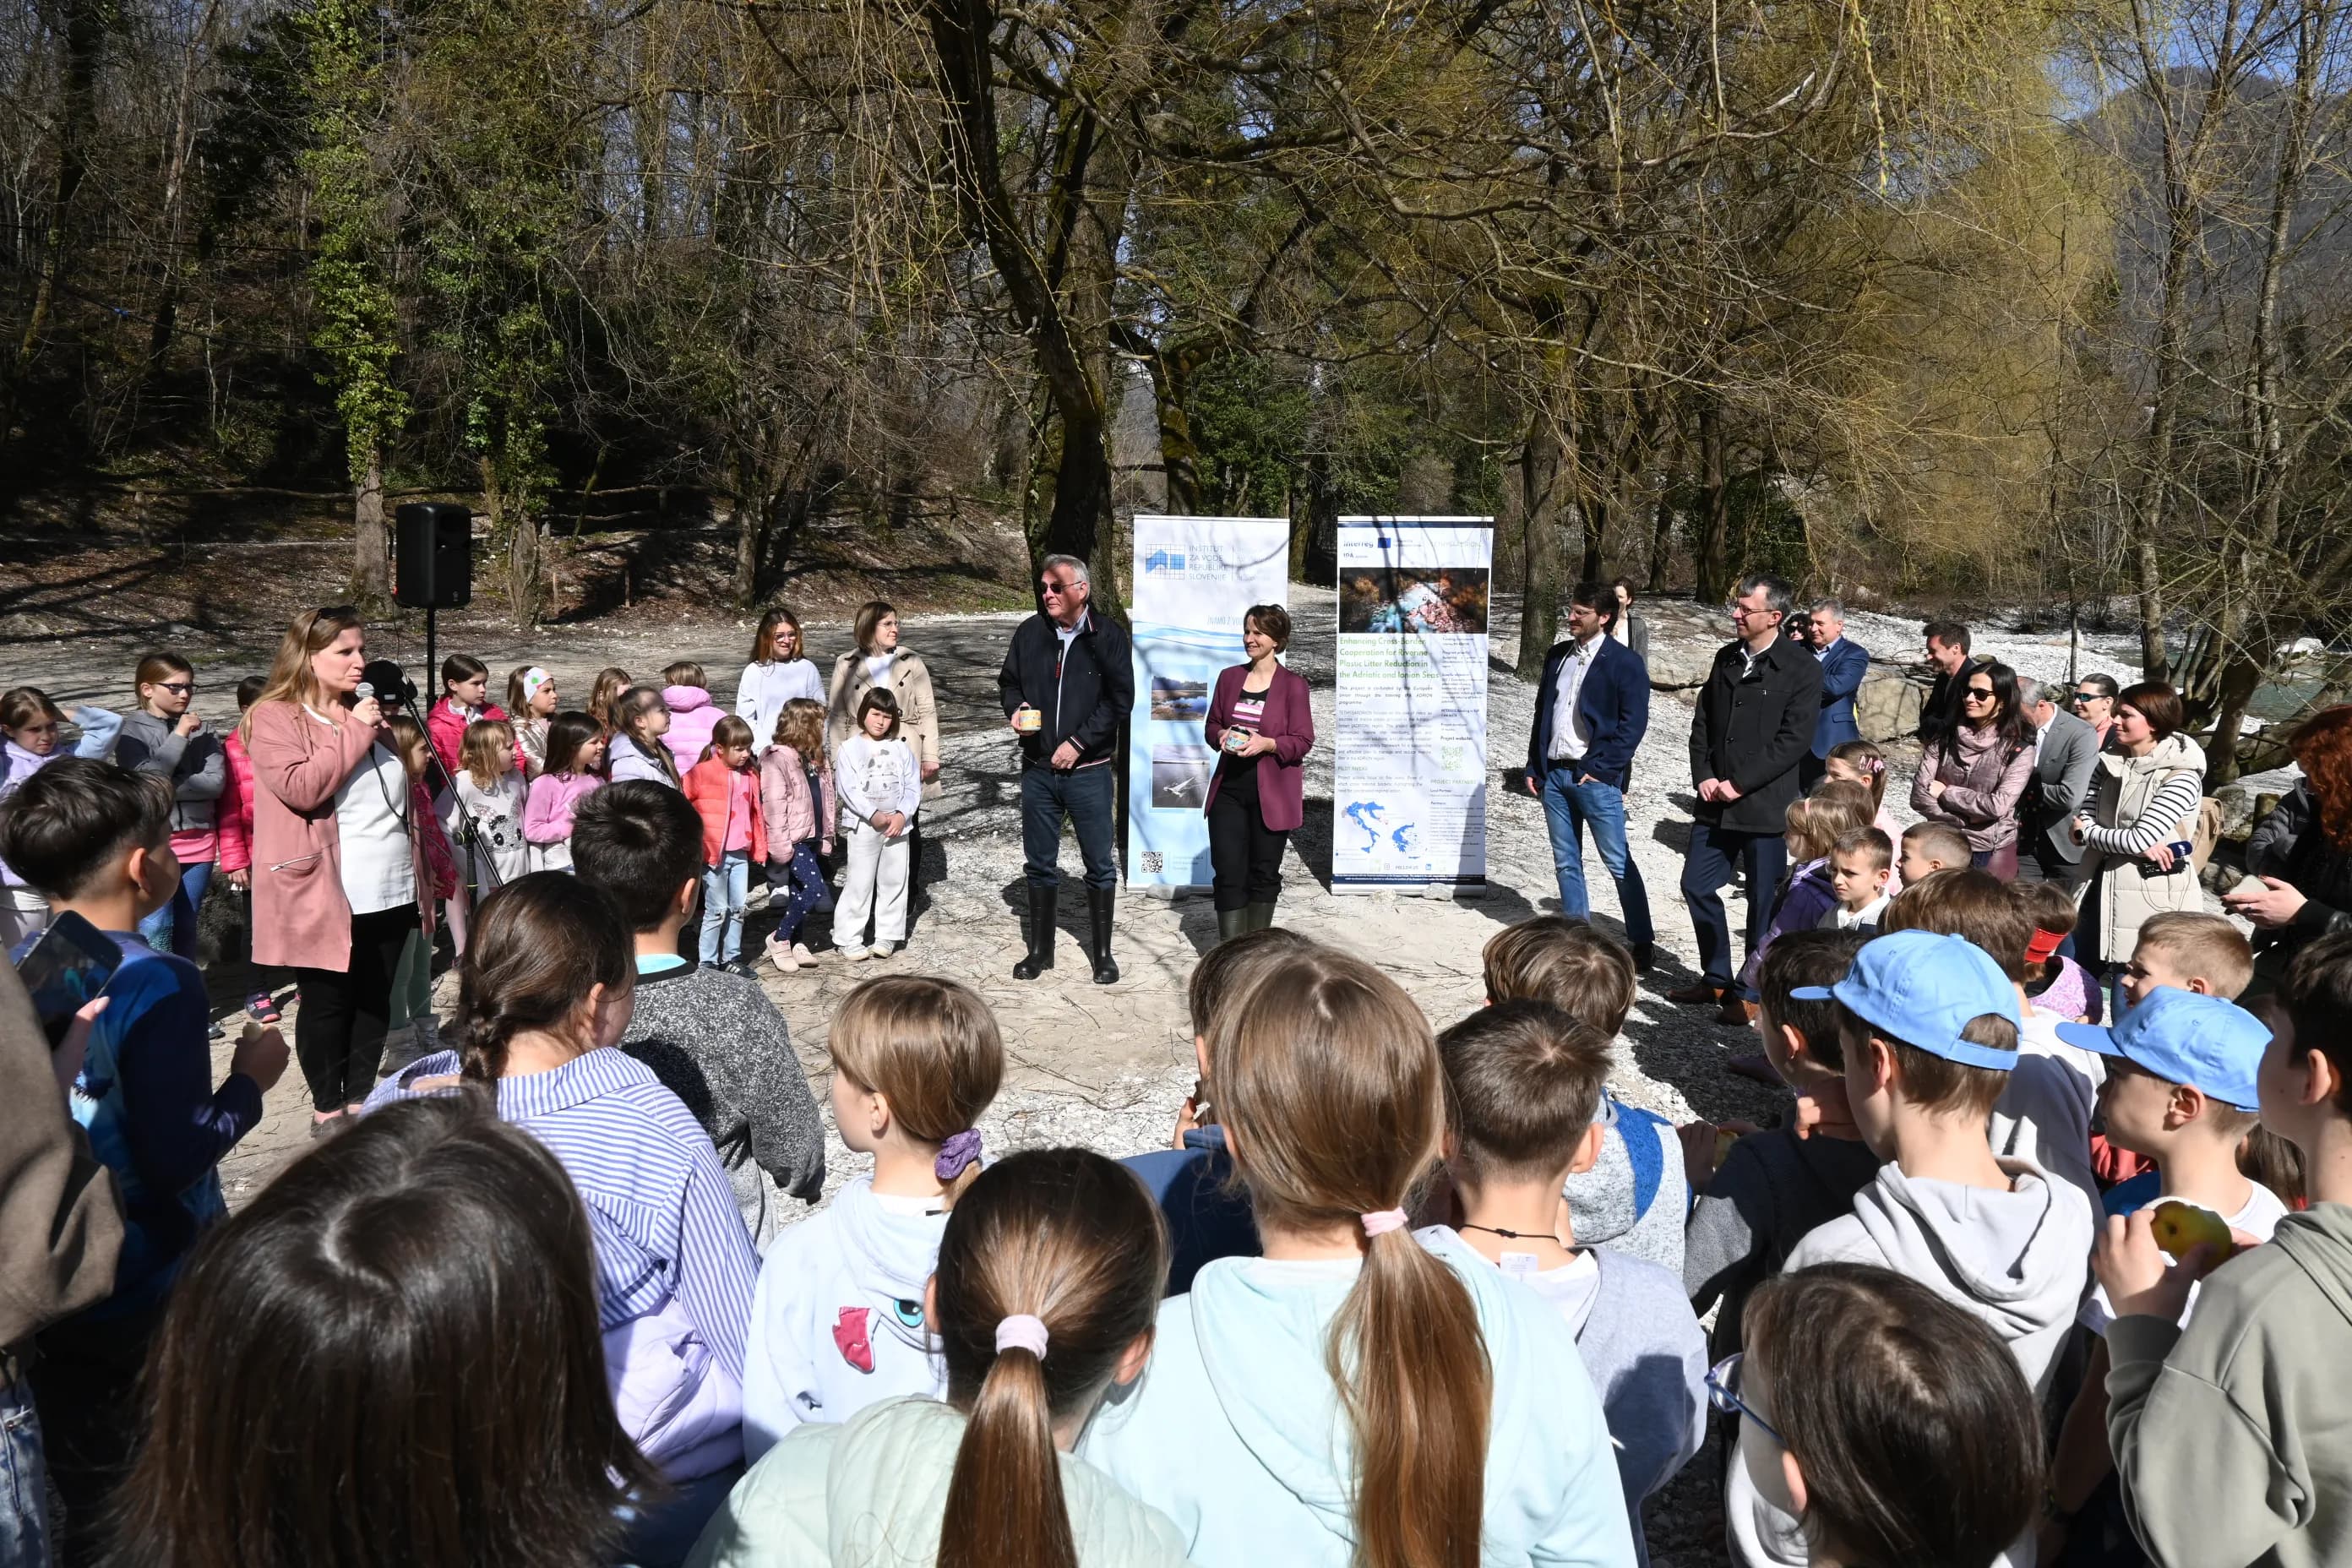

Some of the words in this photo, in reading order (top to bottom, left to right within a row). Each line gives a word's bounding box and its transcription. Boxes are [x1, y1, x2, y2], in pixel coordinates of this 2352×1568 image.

[1339, 637, 1377, 647] Enhancing
[1339, 648, 1385, 656] Cooperation
[1398, 648, 1428, 656] Riverine
[1364, 659, 1383, 667] Litter
[1384, 659, 1420, 667] Reduction
[1421, 659, 1428, 667] in
[1352, 670, 1380, 678] Adriatic
[1382, 670, 1396, 678] and
[1397, 670, 1421, 678] Ionian
[1423, 670, 1440, 678] Seas
